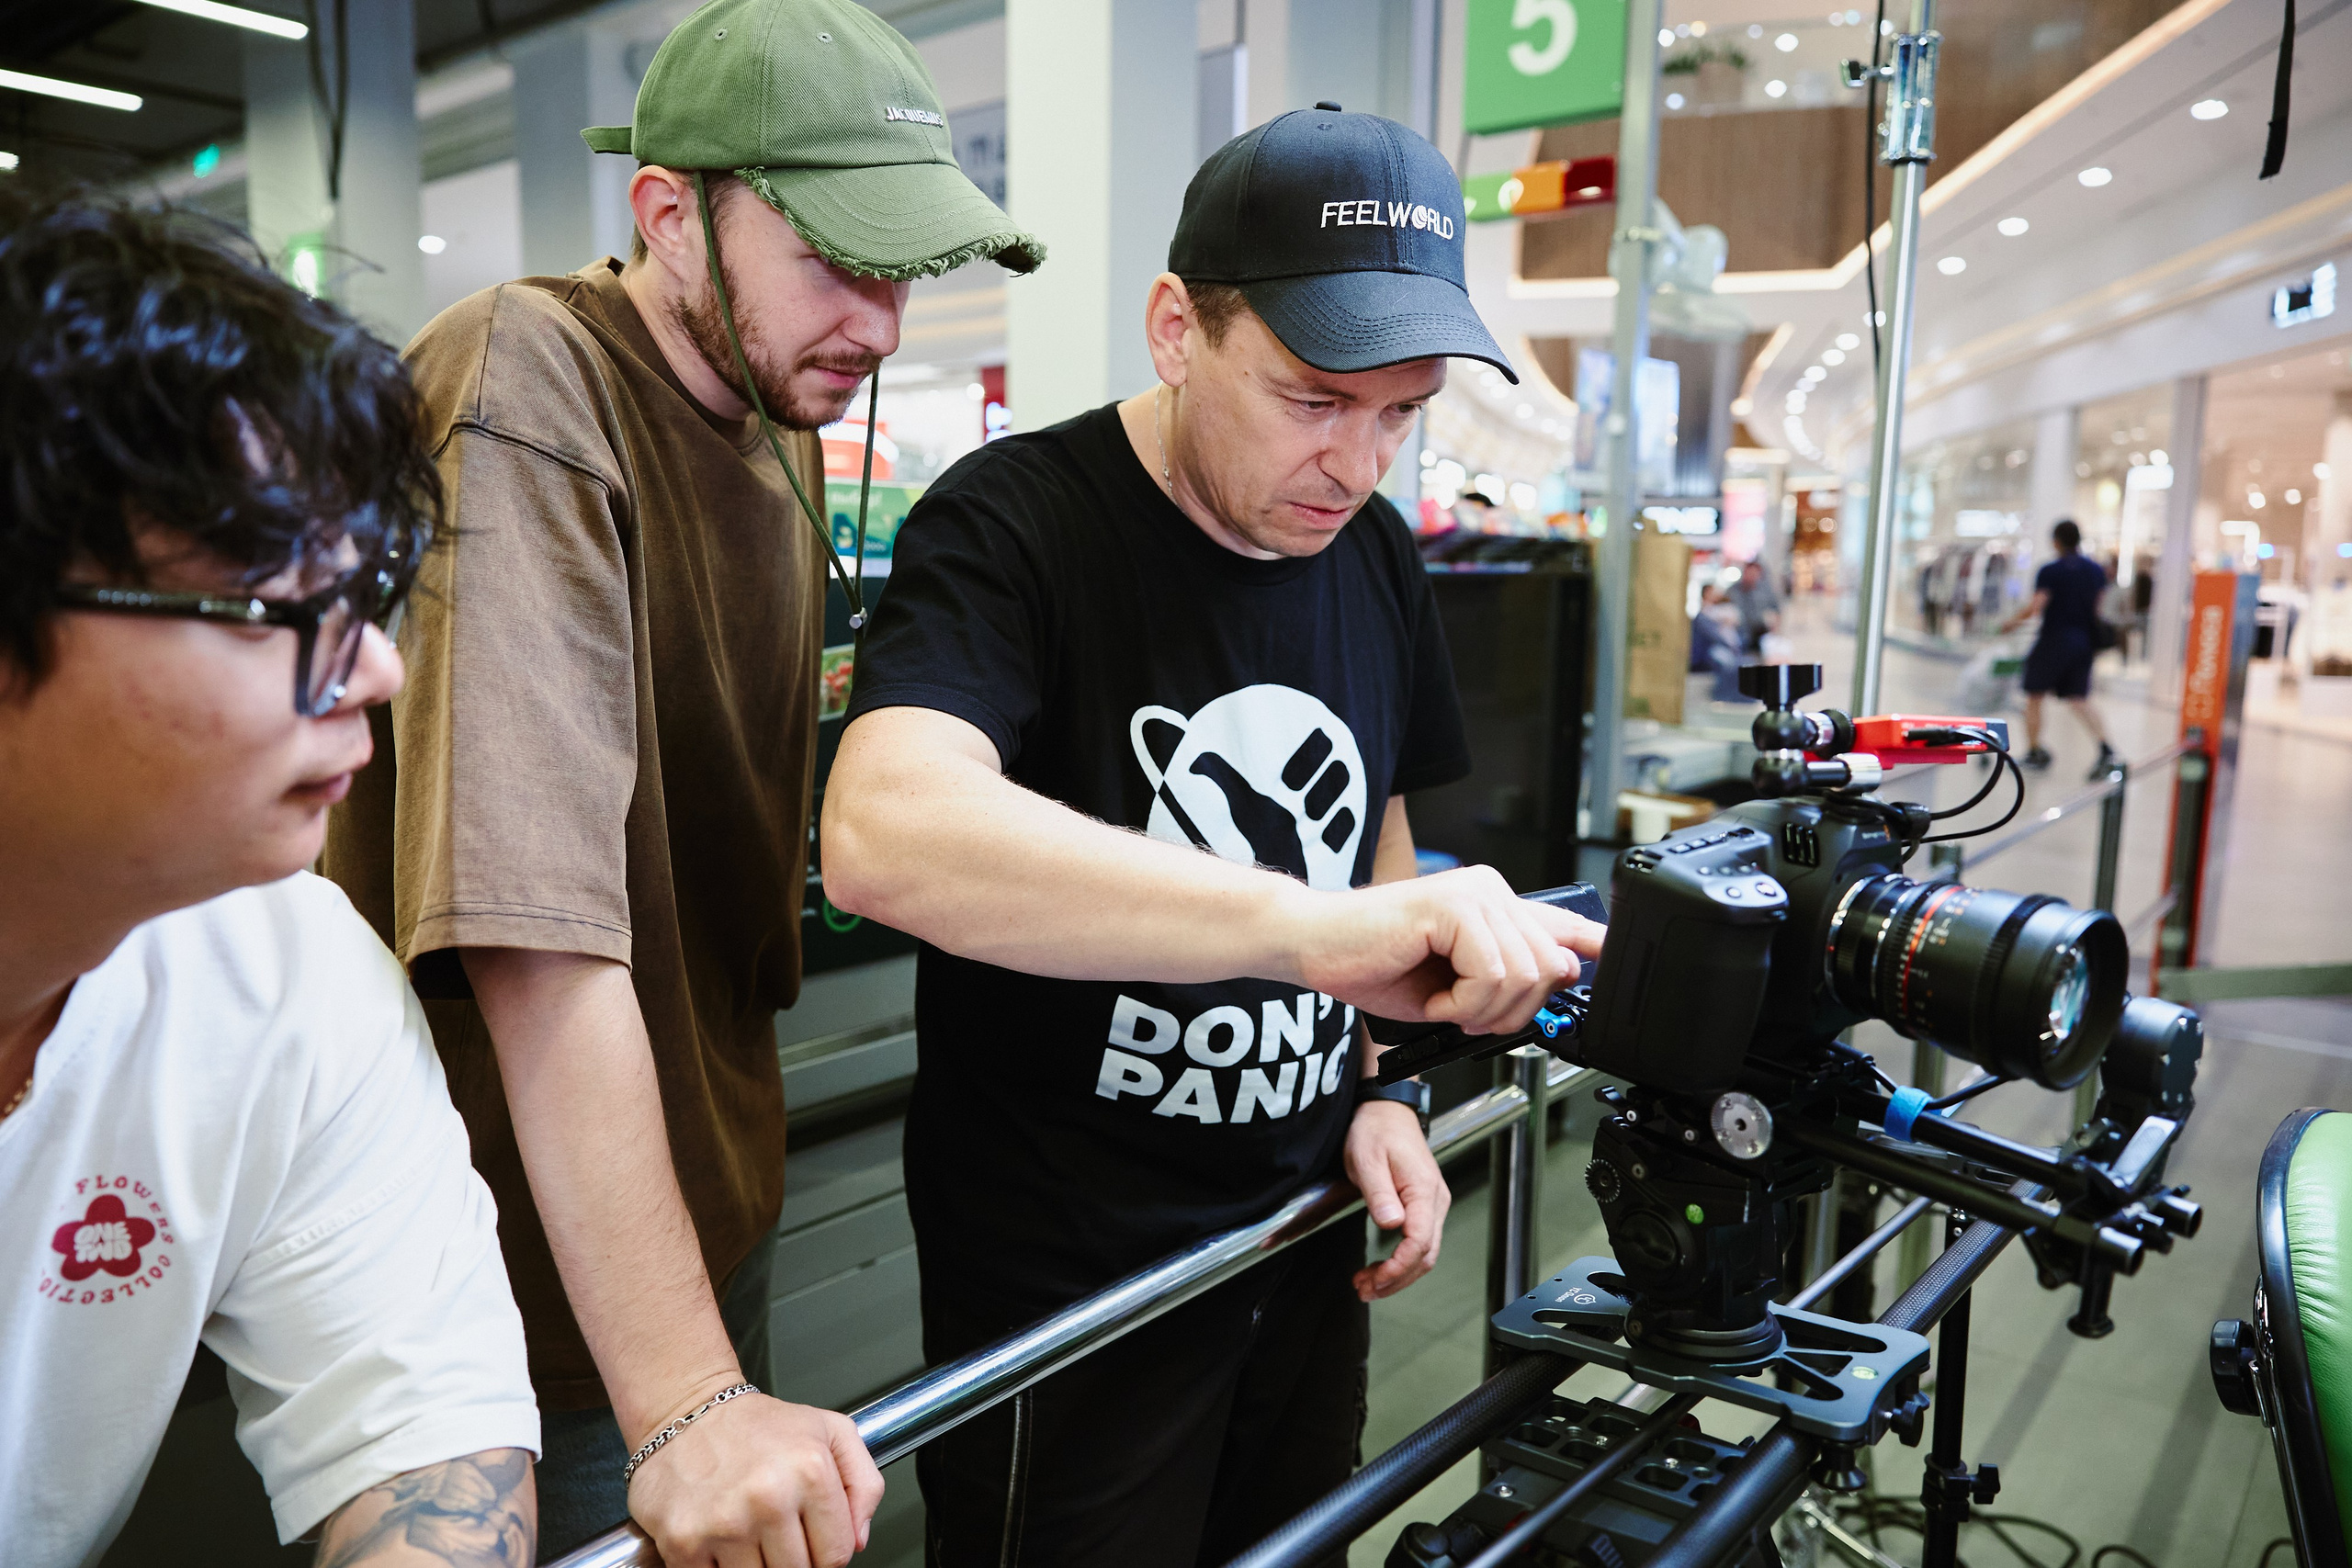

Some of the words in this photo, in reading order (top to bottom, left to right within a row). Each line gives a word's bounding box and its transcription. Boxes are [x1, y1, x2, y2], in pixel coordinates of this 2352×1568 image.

[1508, 0, 1578, 76] 5
[886, 106, 944, 127] JACQUEMUS
[1320, 199, 1454, 241] FEELWORLD
[74, 1221, 132, 1245] ONE
[38, 1254, 173, 1305] COLLECTIO
